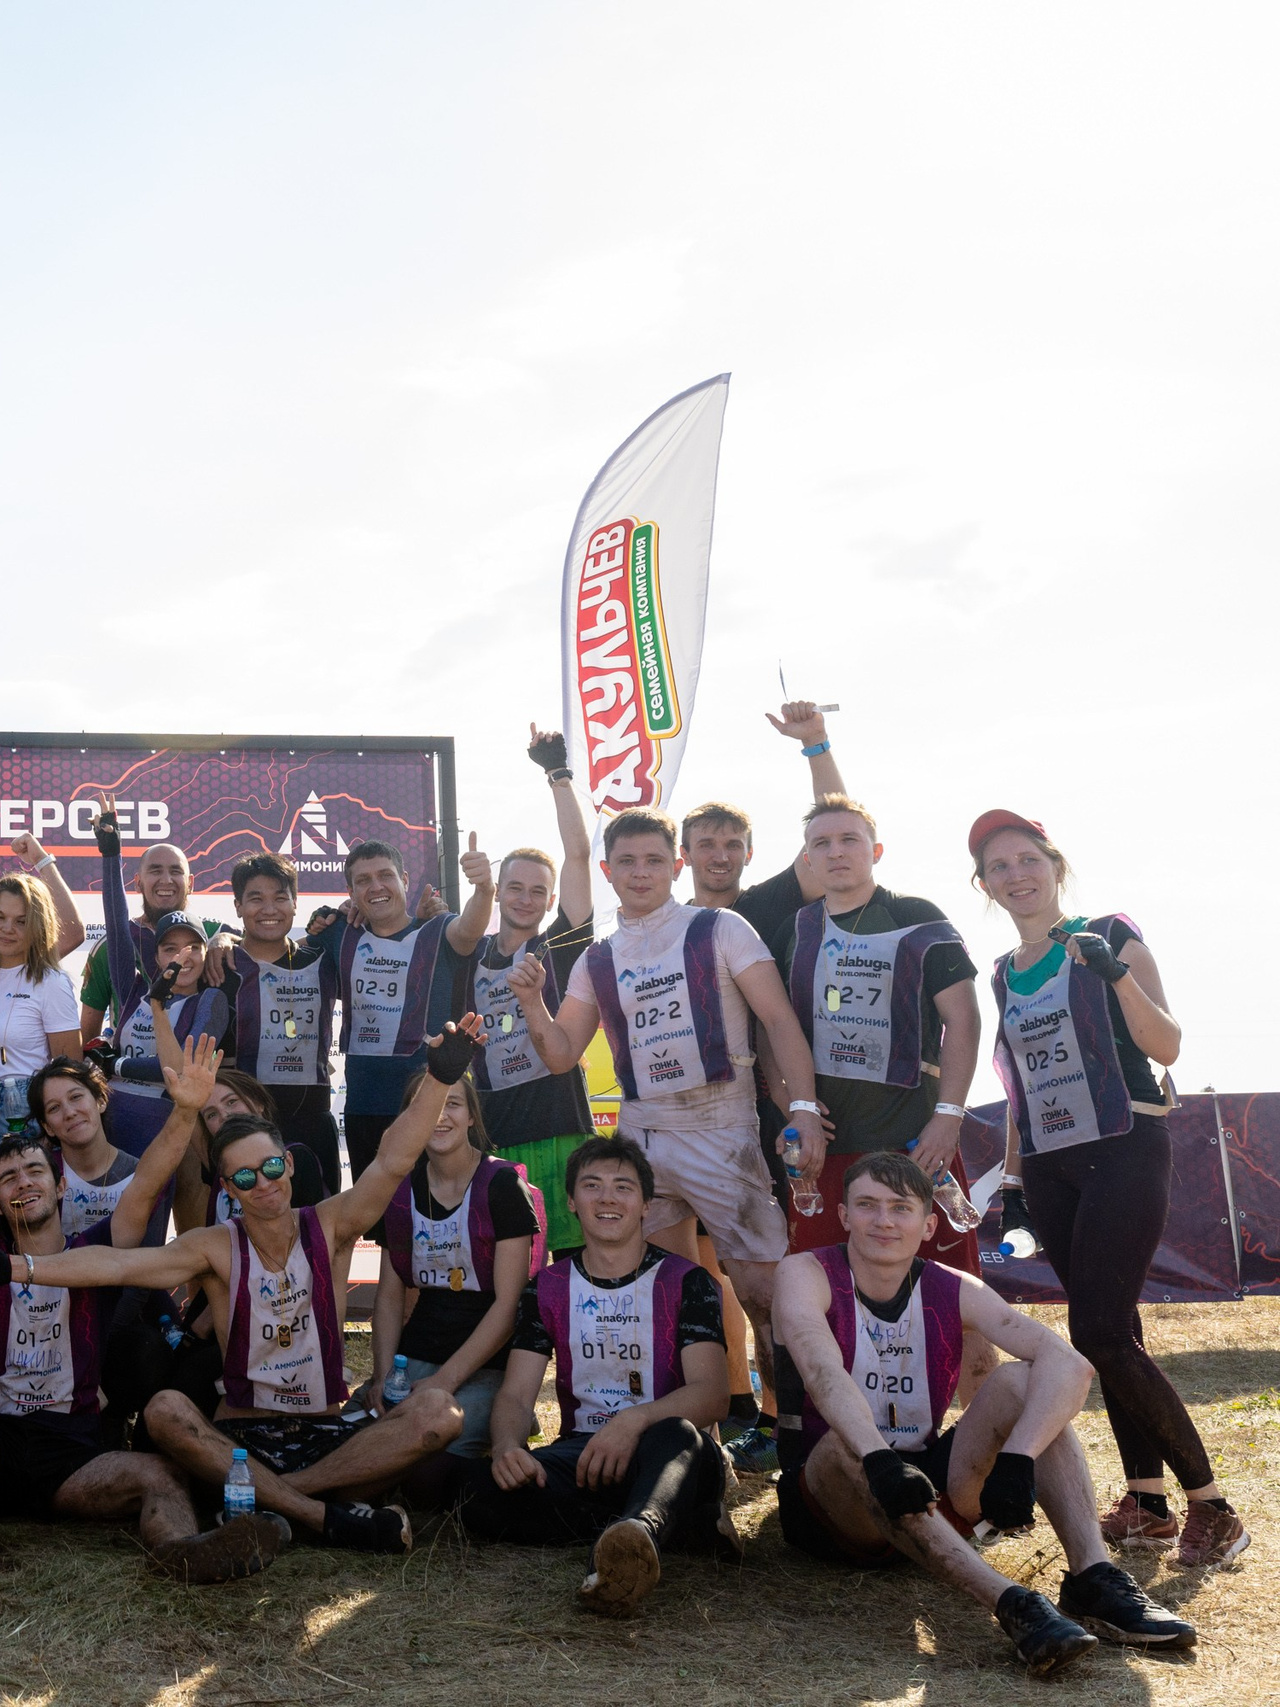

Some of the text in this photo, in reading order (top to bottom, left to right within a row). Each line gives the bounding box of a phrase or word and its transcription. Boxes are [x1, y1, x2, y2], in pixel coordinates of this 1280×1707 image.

[634, 536, 665, 721] семейная компания
[293, 859, 346, 873] ММОНИ
[365, 956, 408, 969] alabuga
[836, 956, 892, 972] alabuga
[363, 967, 400, 975] DEVELOPMENT
[835, 970, 882, 979] DEVELOPMENT
[355, 978, 398, 998] 02-9
[634, 971, 685, 993] alabuga
[275, 985, 320, 997] alabuga
[488, 985, 513, 999] alab
[636, 985, 678, 1002] DEVELOPMENT
[361, 1003, 402, 1013] АММОНИЙ
[635, 1000, 682, 1029] 02-2
[132, 1022, 155, 1033] alab
[829, 1014, 890, 1029] АММОНИЙ
[1019, 1008, 1070, 1033] alabuga
[276, 1032, 319, 1040] АМОНИЙ
[360, 1026, 380, 1034] ГОНКА
[494, 1027, 530, 1044] АММОН
[1022, 1025, 1062, 1043] DEVELOPMENT
[357, 1036, 381, 1044] ГЕРОЕВ
[831, 1041, 866, 1053] ГОНКА
[275, 1055, 303, 1063] ГОНКА
[501, 1052, 528, 1066] ГОНКА
[829, 1053, 867, 1065] ГЕРОЕВ
[1025, 1041, 1070, 1072] 02-5
[272, 1065, 304, 1073] ГЕРОЕВ
[500, 1061, 533, 1077] ГЕРОЕВ
[648, 1059, 681, 1073] ГОНКА
[649, 1069, 685, 1084] ГЕРОЕВ
[1041, 1107, 1071, 1122] ГОНКА
[1042, 1119, 1076, 1135] ГЕРОЕВ
[427, 1240, 462, 1252] алабуга
[595, 1313, 641, 1326] алабуга
[262, 1314, 310, 1340] 020
[582, 1342, 642, 1361] 01-20
[273, 1353, 314, 1371] АММОНИЙ
[18, 1392, 54, 1402] ГОНКА
[273, 1393, 312, 1406] ГЕРОЕВ
[599, 1388, 645, 1398] АММОН
[876, 1423, 919, 1434] ММОНИЙ
